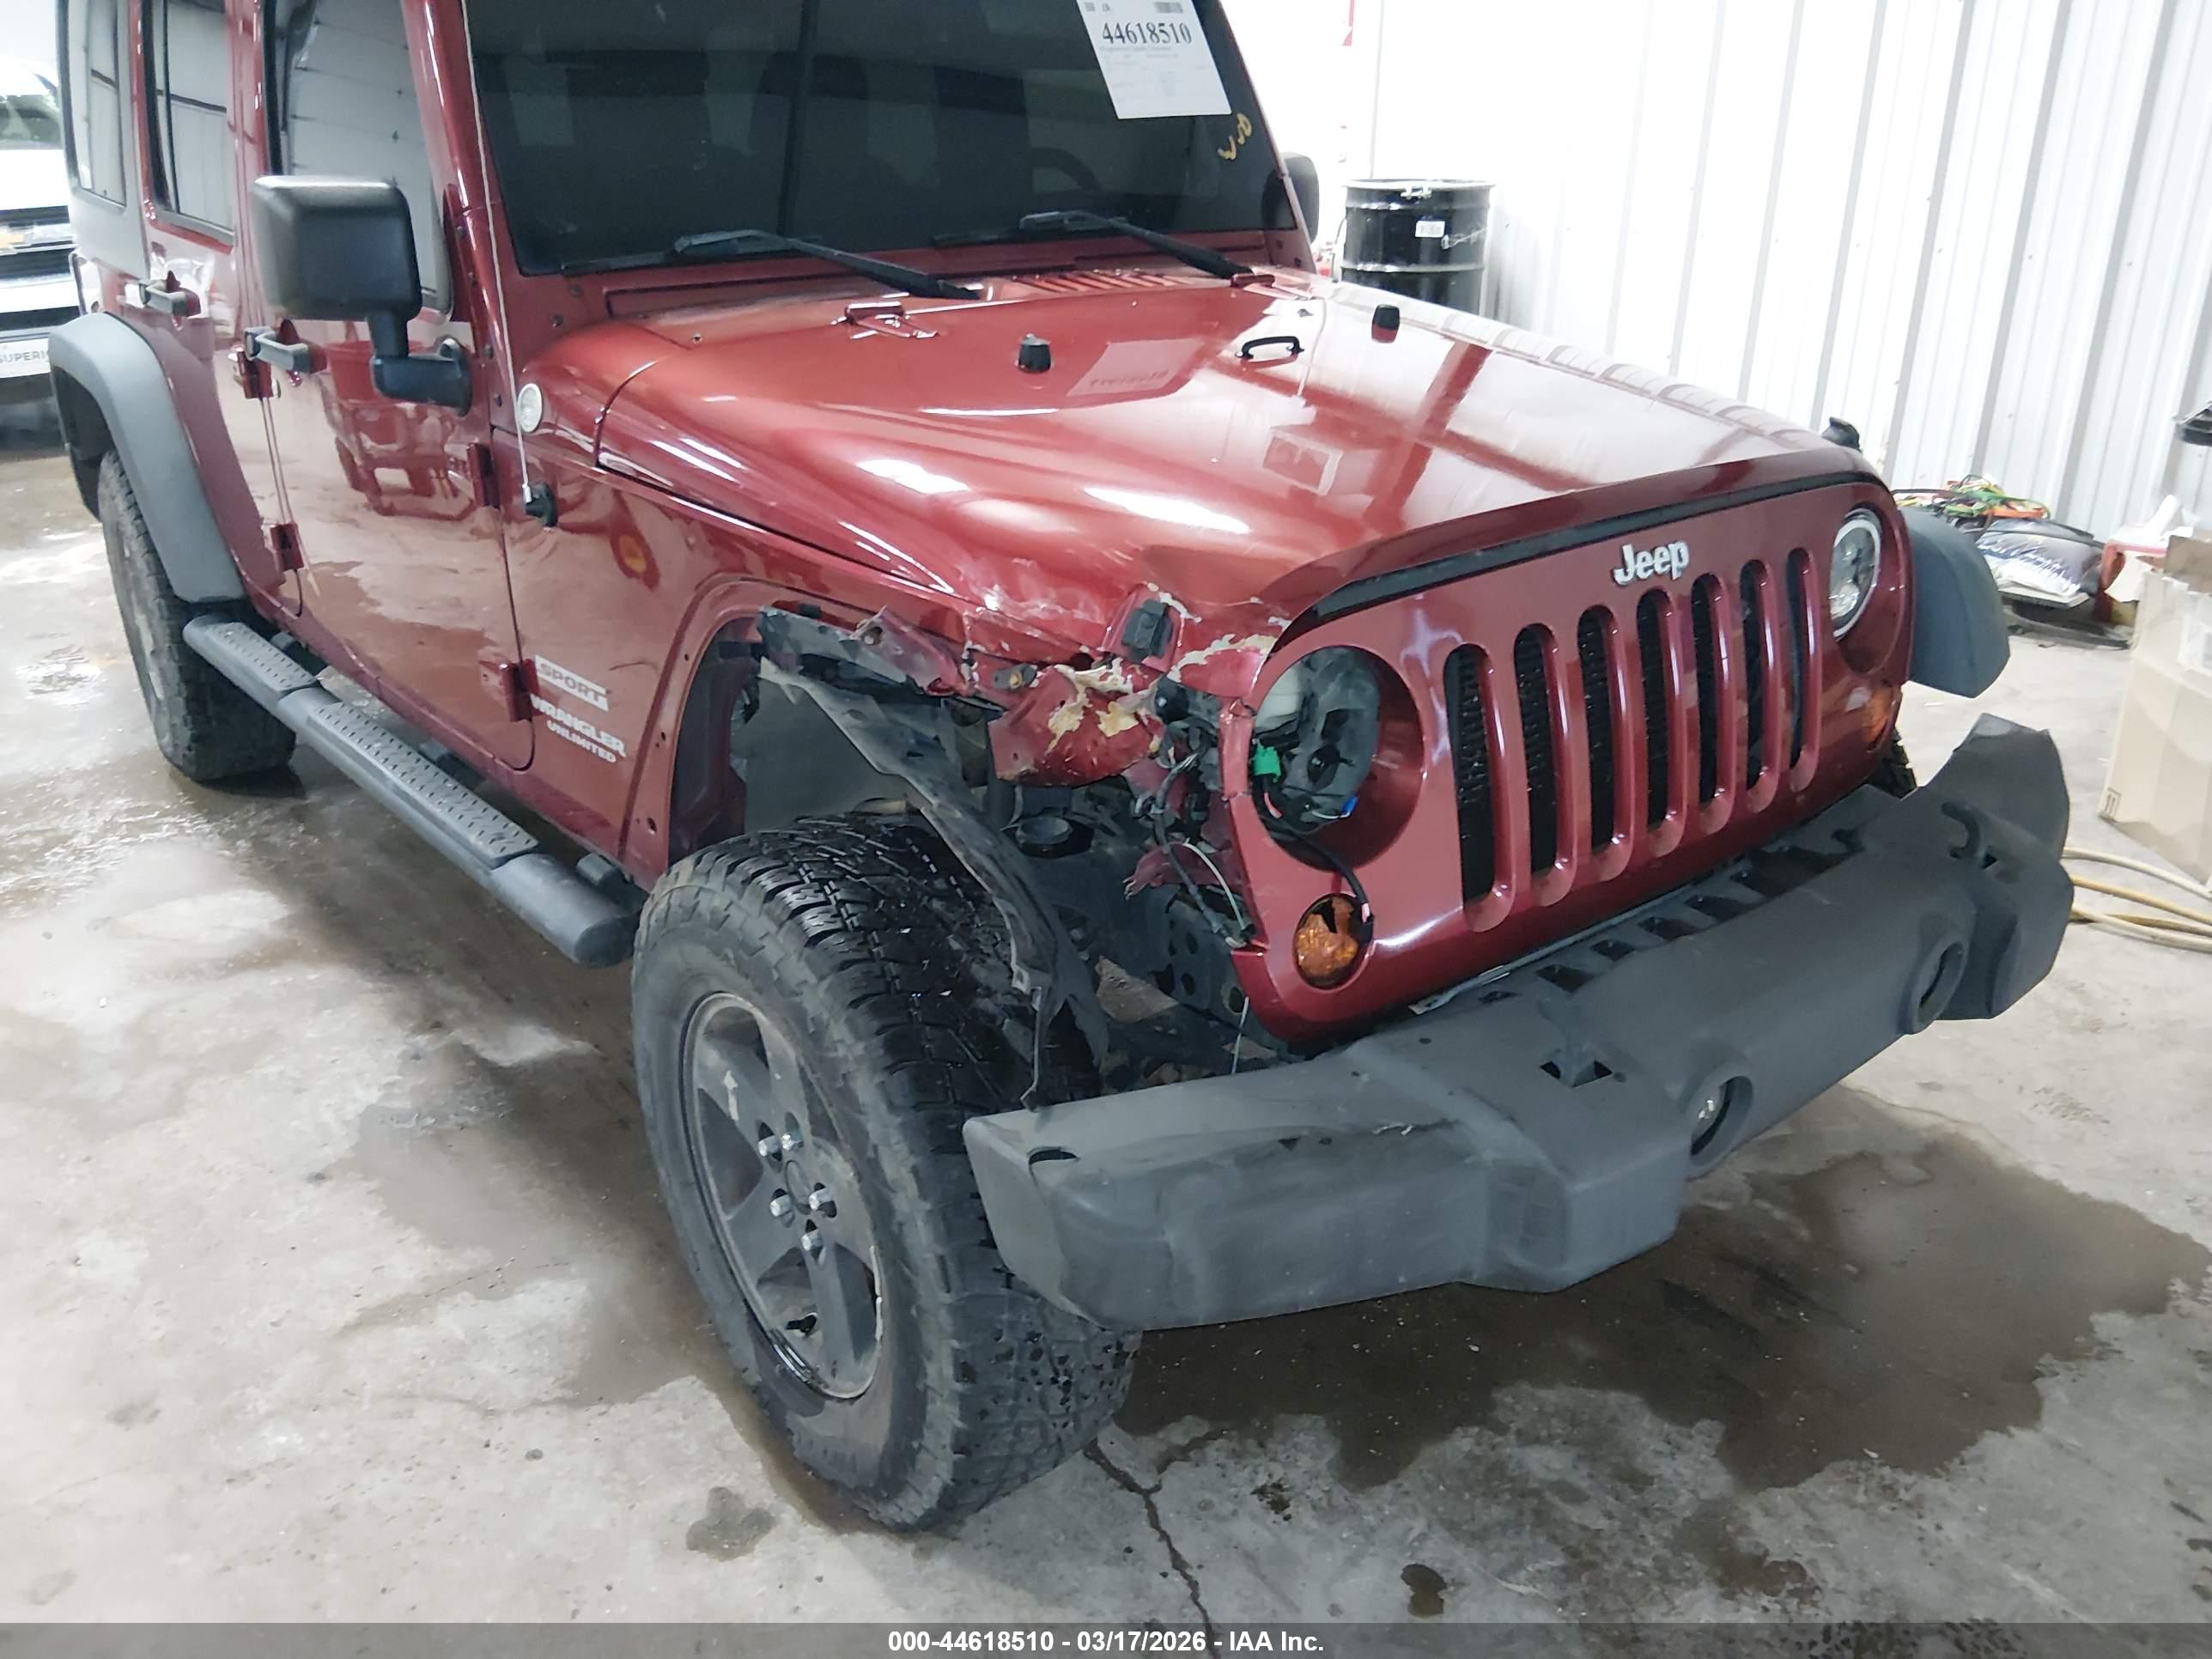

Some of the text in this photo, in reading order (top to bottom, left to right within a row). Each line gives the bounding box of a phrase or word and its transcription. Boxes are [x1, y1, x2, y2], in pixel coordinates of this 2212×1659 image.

[1103, 21, 1193, 44] 44618510
[1613, 541, 1690, 586] Jeep
[538, 660, 608, 703] SPORT
[530, 693, 626, 757] WRANGLER
[547, 720, 617, 763] UNLIMITED
